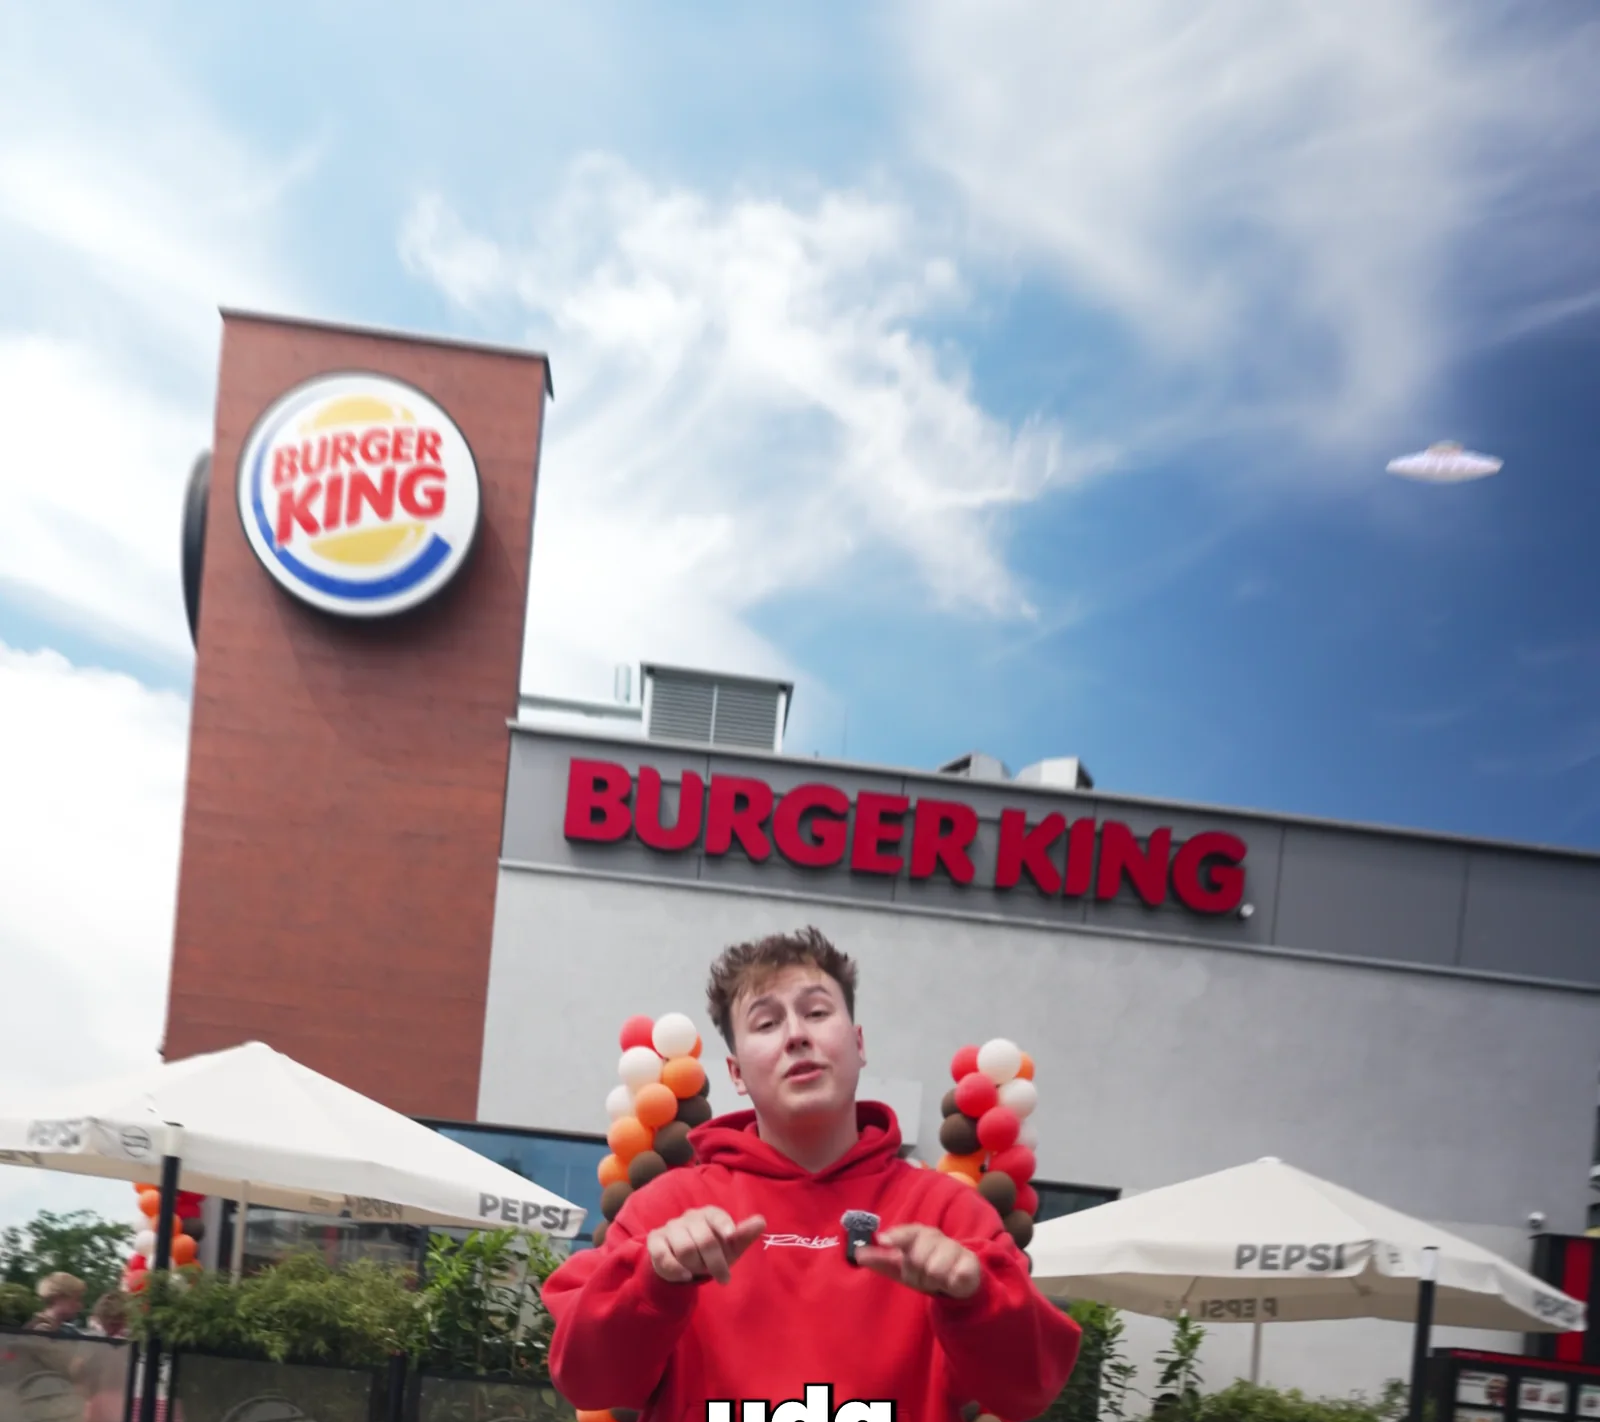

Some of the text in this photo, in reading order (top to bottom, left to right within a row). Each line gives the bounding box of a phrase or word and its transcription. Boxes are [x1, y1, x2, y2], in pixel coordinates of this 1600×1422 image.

[272, 426, 443, 488] BURGER
[275, 464, 447, 546] KING
[564, 757, 1247, 914] BURGER KING
[478, 1192, 571, 1231] PEPSI
[1234, 1243, 1346, 1271] PEPSI
